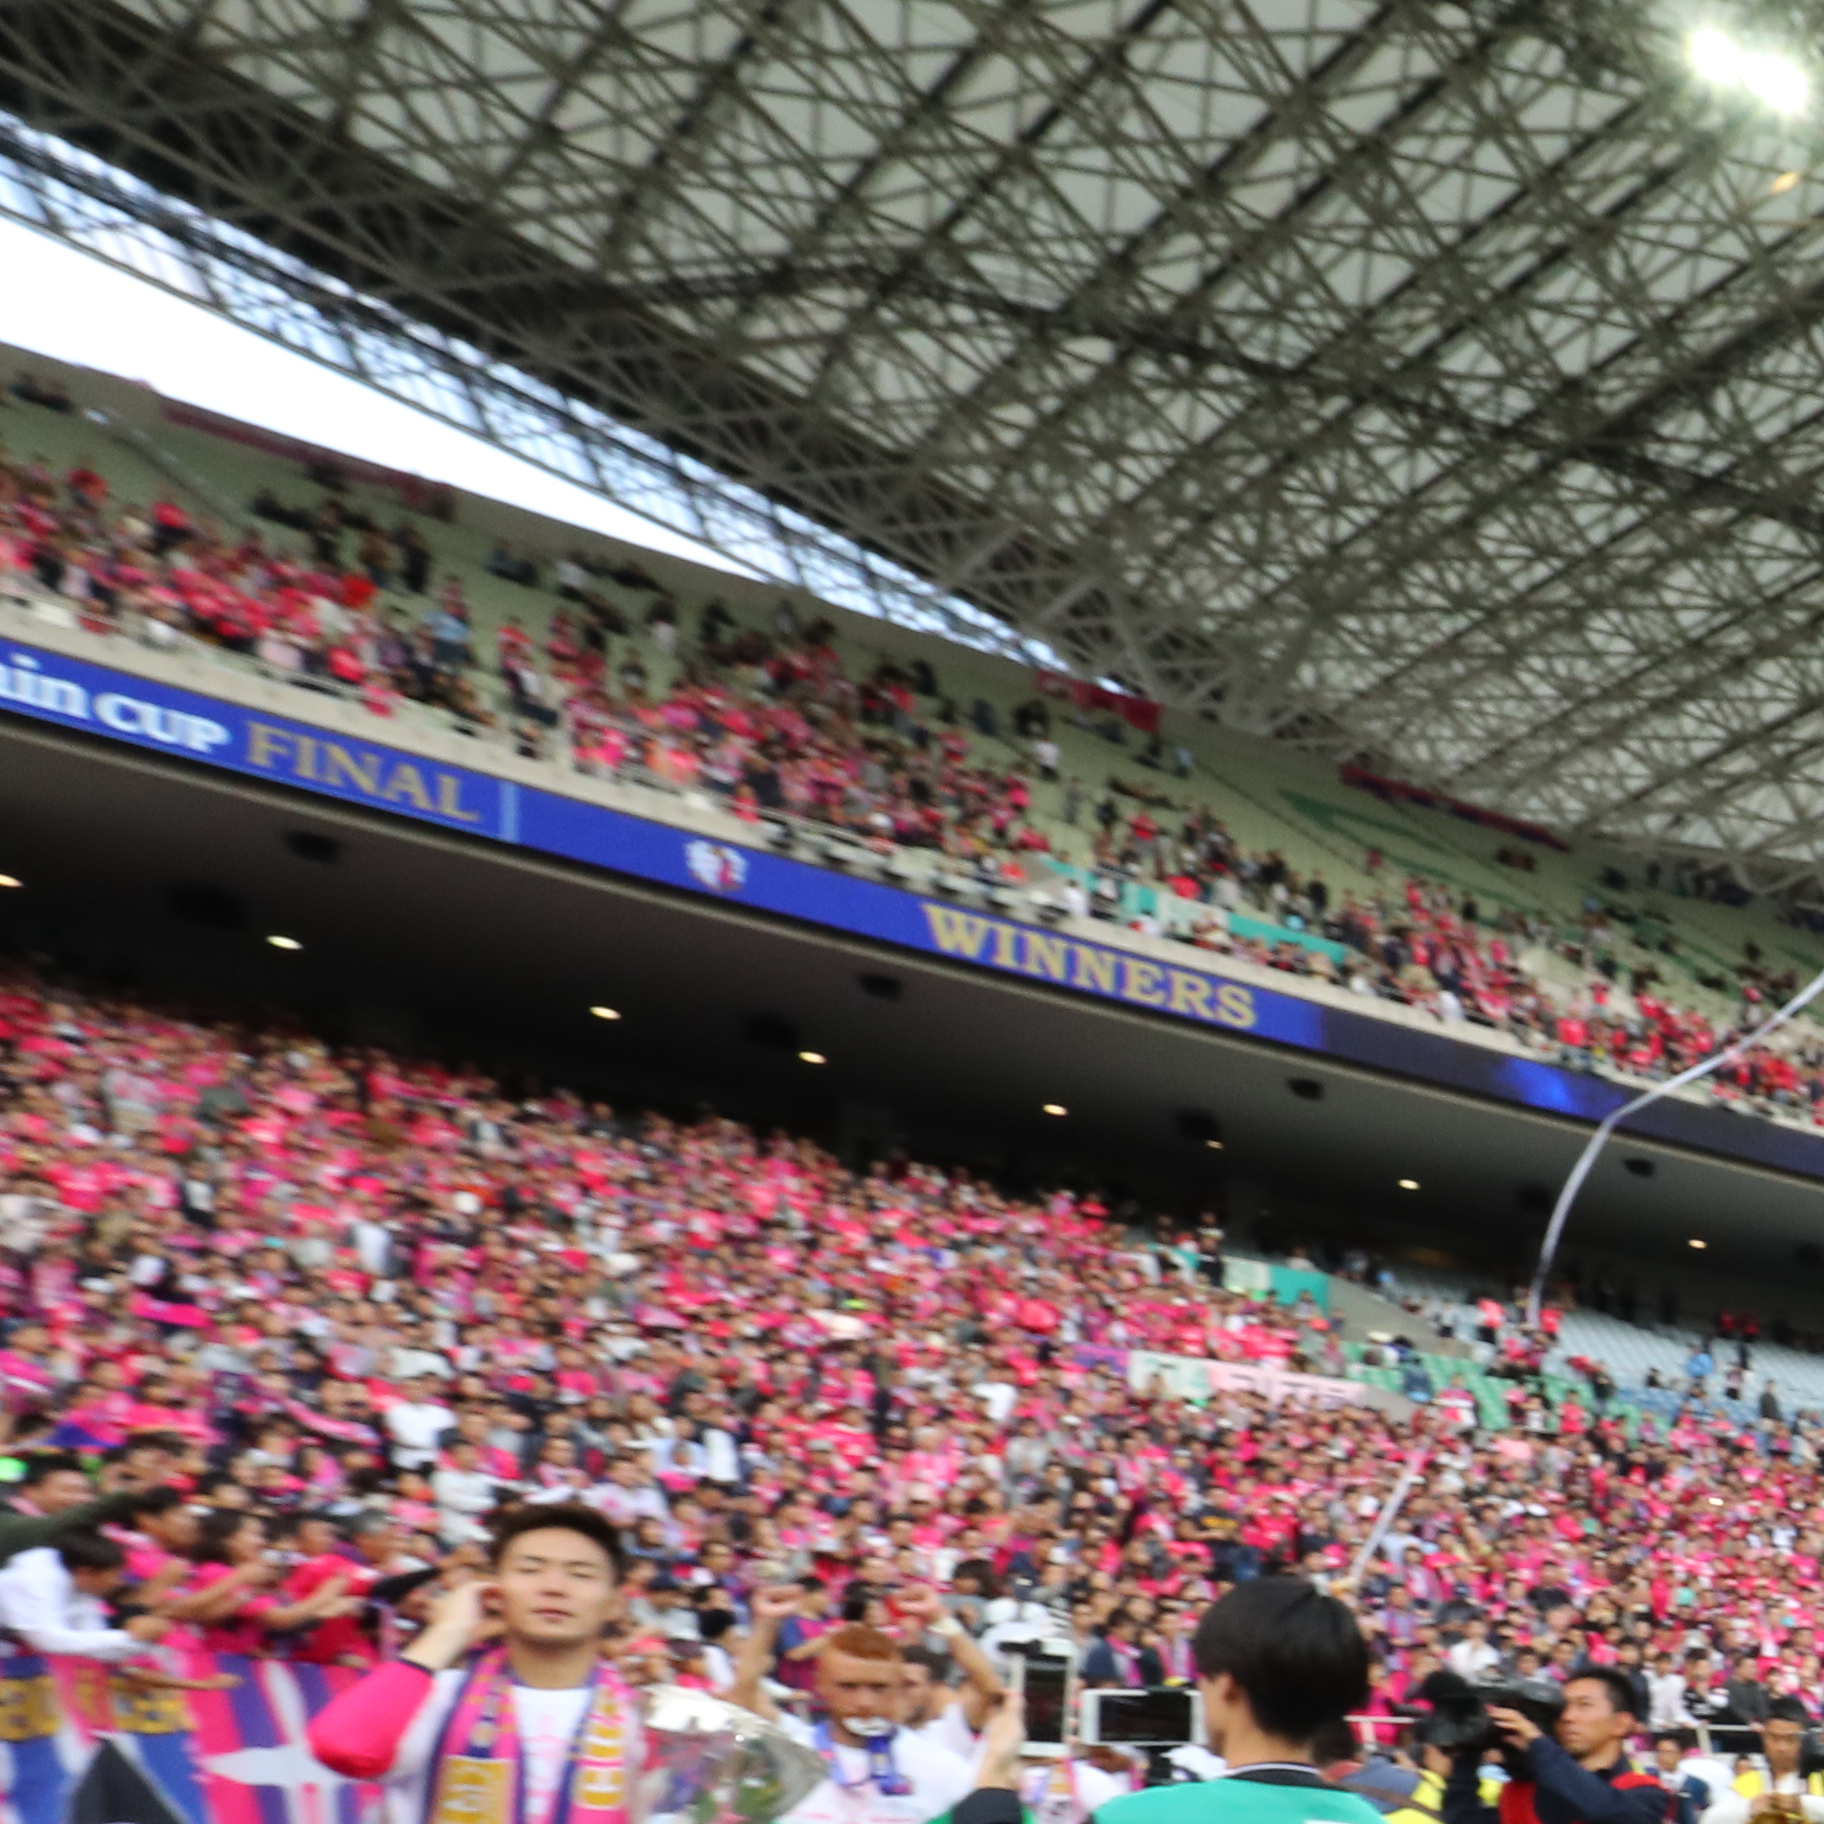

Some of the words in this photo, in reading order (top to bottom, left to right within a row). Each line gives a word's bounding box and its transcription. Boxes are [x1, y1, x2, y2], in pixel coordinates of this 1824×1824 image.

[95, 692, 232, 754] CUP
[247, 720, 481, 822] FINAL
[922, 901, 1258, 1031] WINNERS
